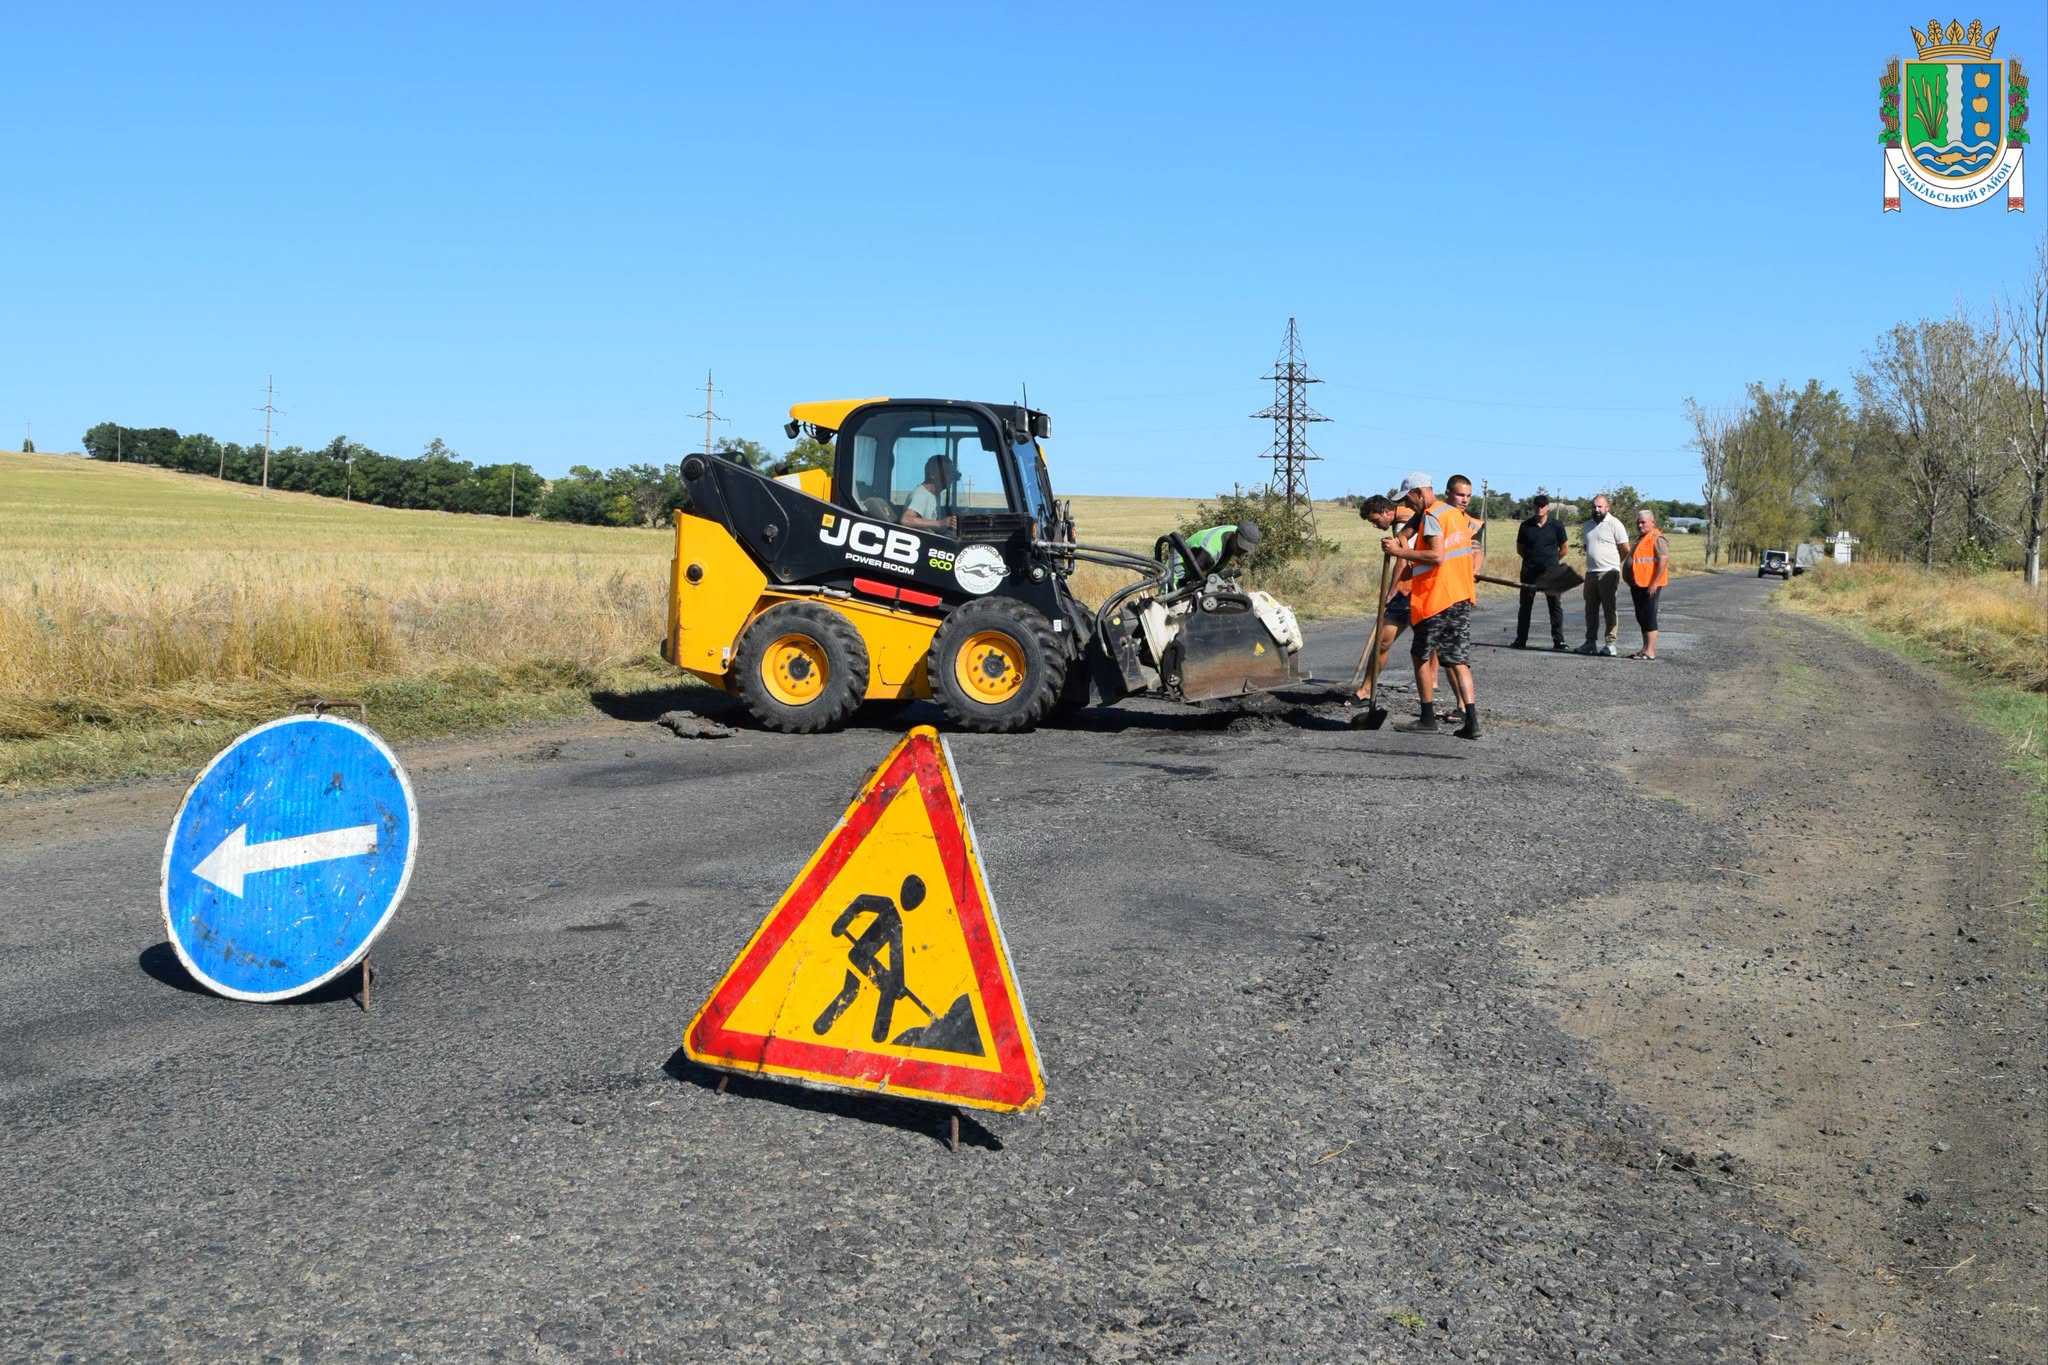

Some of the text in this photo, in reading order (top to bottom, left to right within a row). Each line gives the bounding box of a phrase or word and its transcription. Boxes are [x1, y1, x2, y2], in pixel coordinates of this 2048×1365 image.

[819, 517, 921, 564] JCB
[845, 552, 915, 576] POWER BOOM
[928, 548, 955, 562] 260
[929, 558, 953, 571] eco
